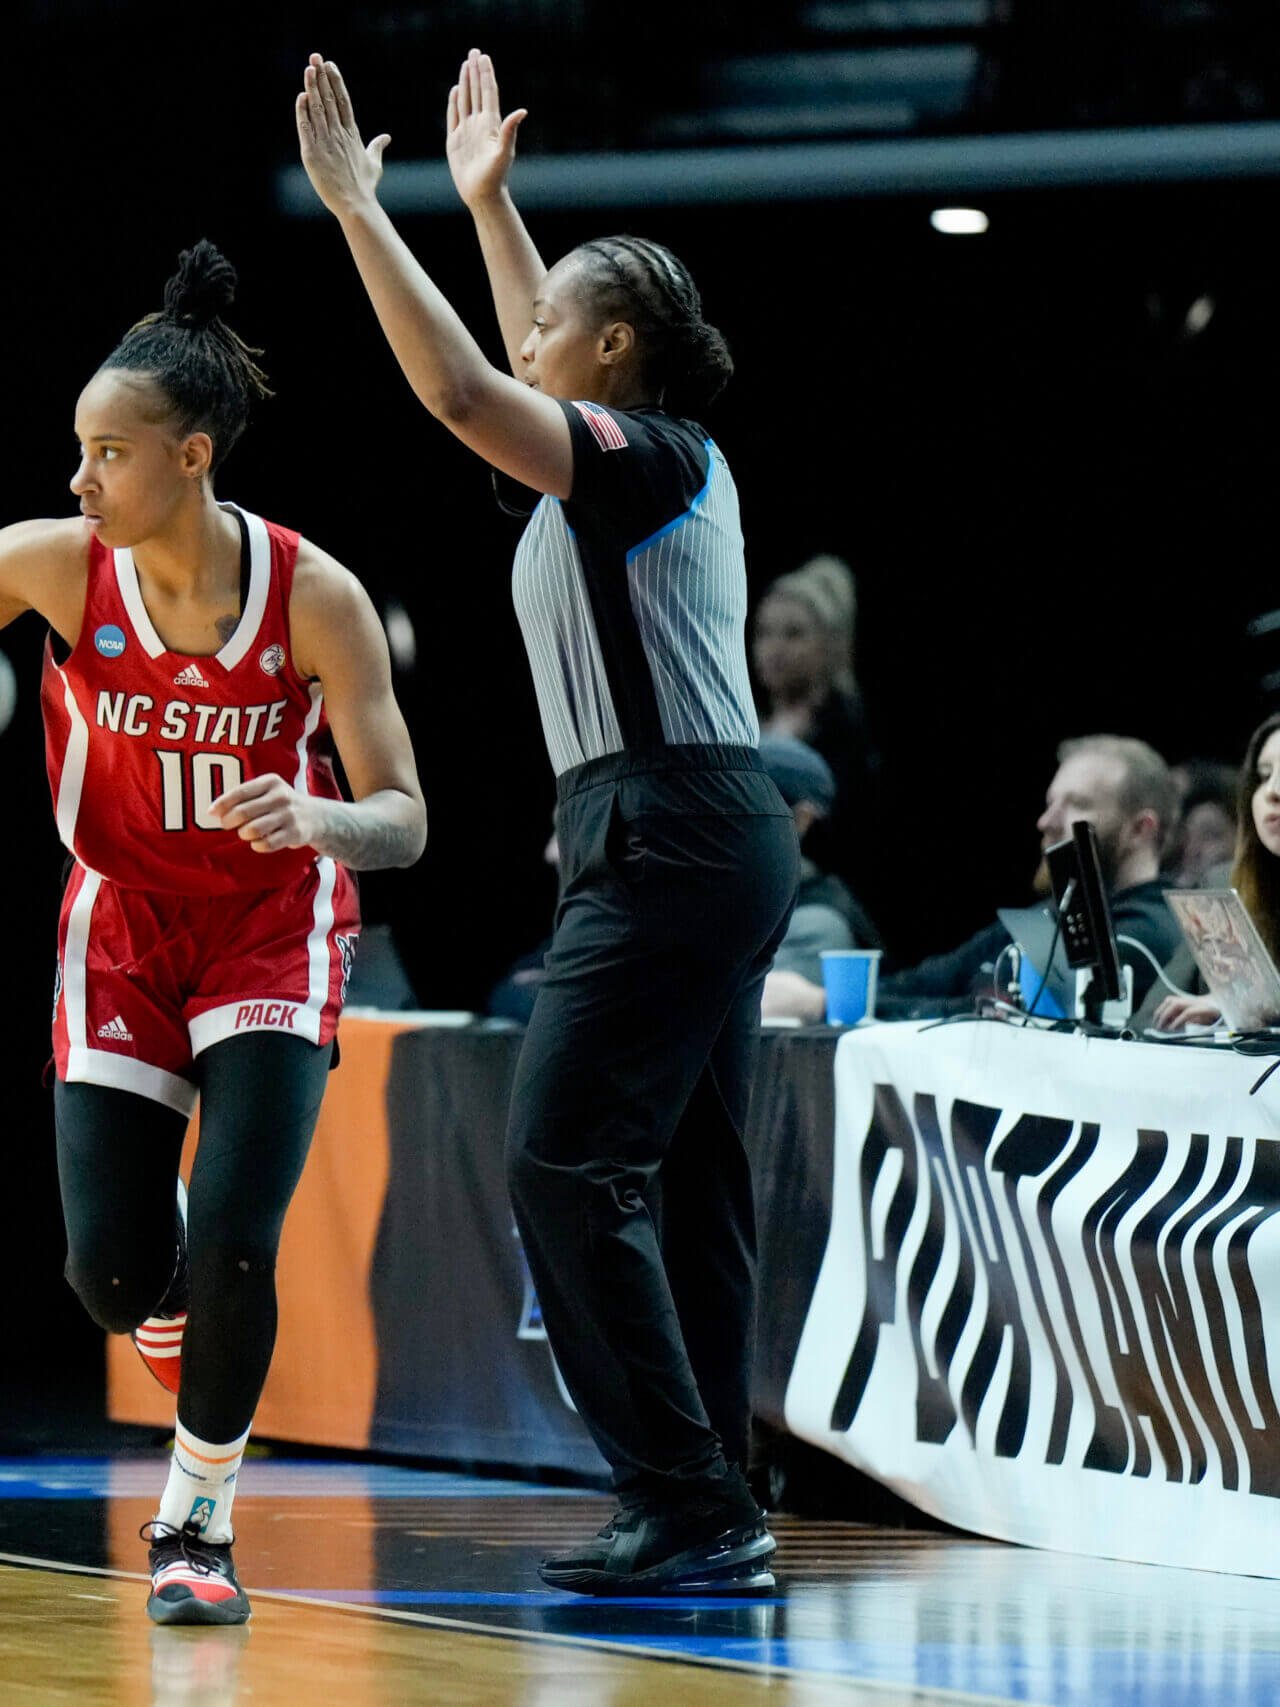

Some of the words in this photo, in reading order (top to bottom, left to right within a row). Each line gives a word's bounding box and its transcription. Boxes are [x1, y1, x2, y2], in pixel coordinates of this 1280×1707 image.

[98, 639, 124, 651] NCAA
[173, 676, 209, 688] adidas
[96, 690, 154, 737] NC
[159, 699, 287, 747] STATE
[154, 750, 243, 831] 10
[235, 1003, 297, 1029] PACK
[97, 1028, 133, 1042] adidas
[829, 1082, 1280, 1499] PORTLAND
